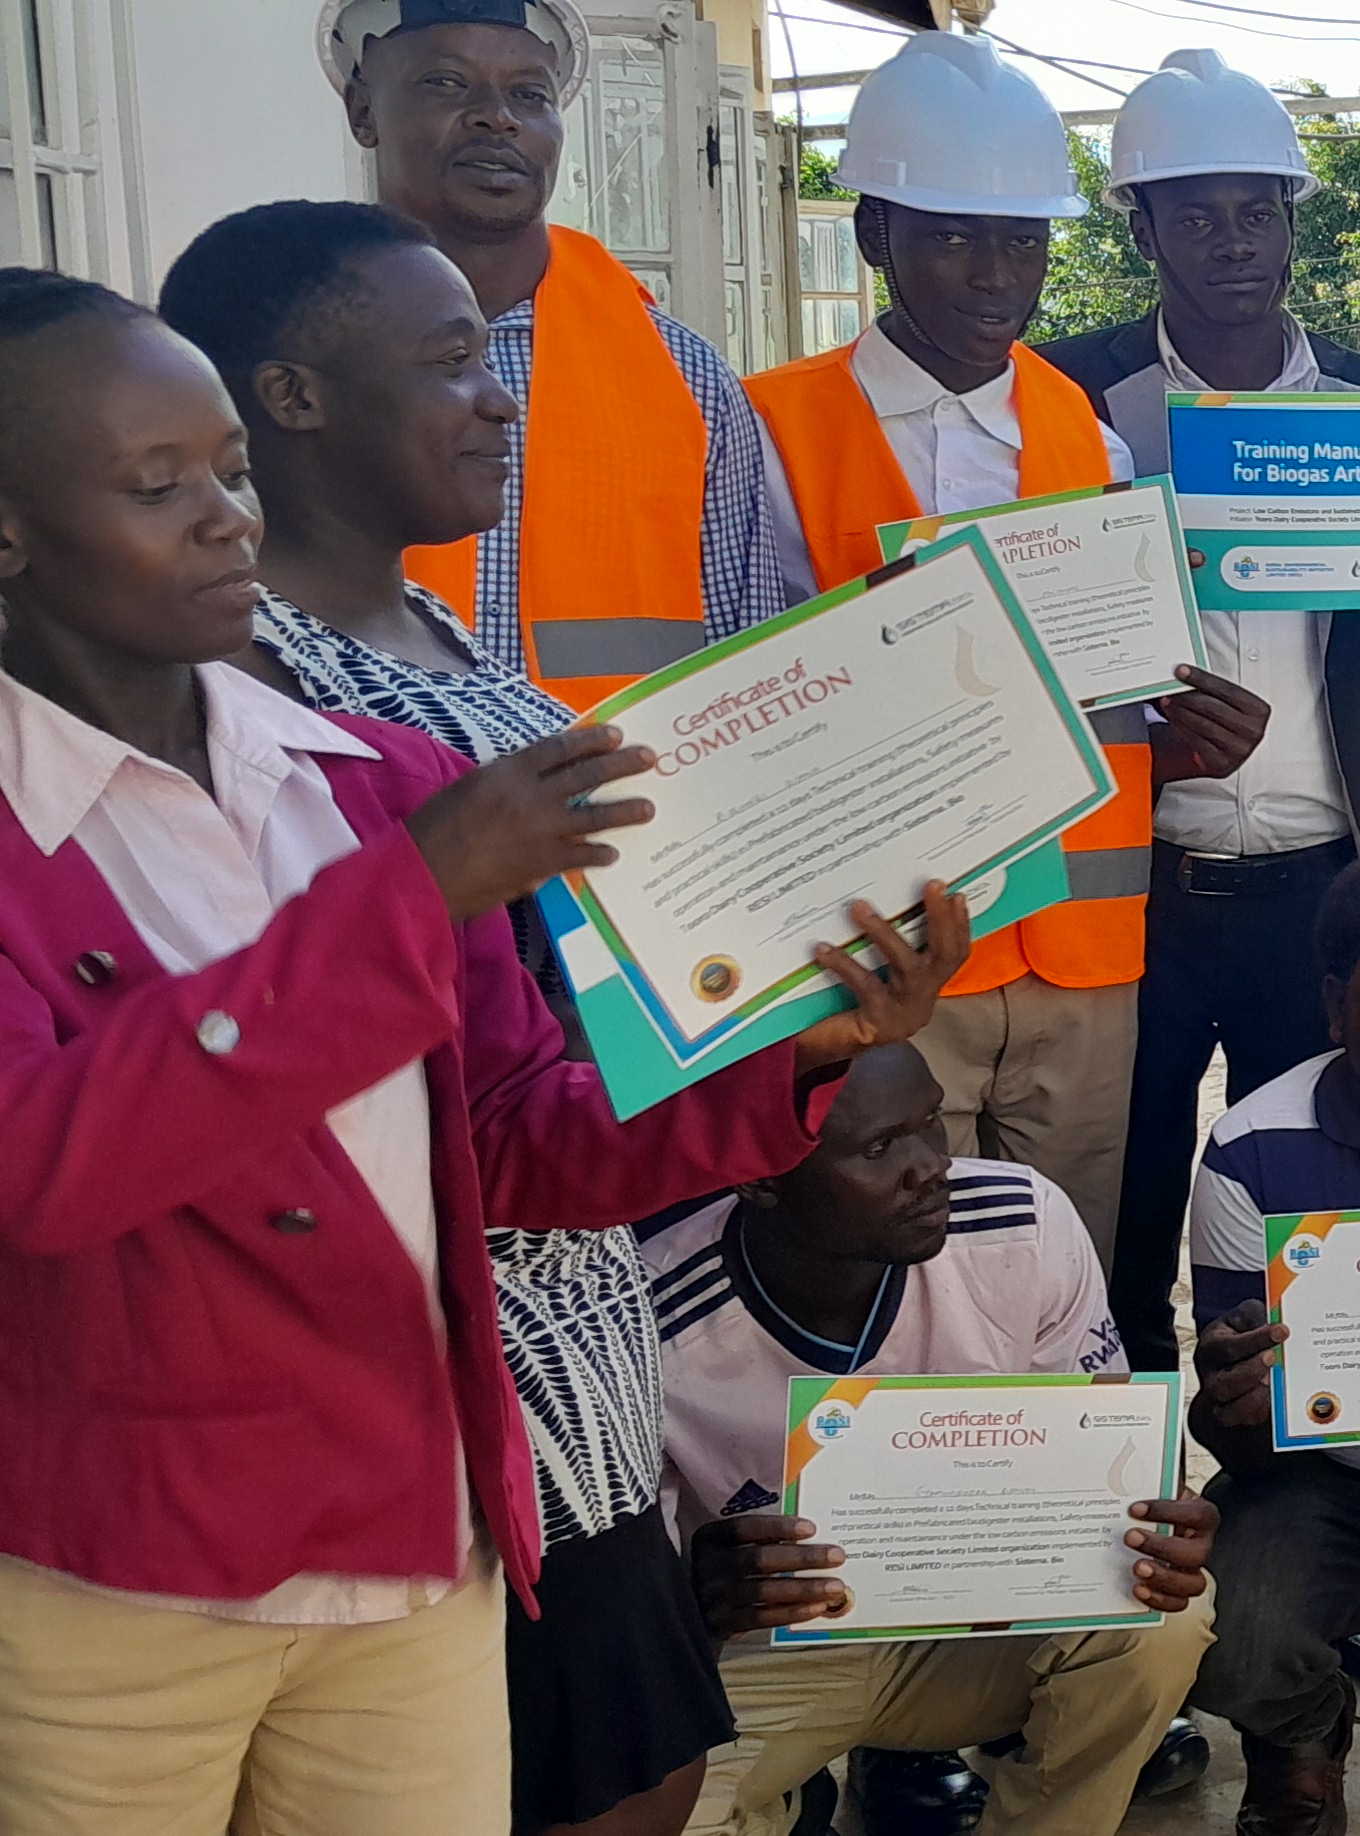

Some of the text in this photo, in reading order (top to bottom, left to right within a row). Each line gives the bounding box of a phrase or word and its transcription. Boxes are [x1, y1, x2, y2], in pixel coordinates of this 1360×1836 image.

[1232, 440, 1309, 463] Training
[1233, 461, 1262, 481] for
[1266, 463, 1329, 486] Biogas
[1047, 522, 1059, 538] of
[1002, 535, 1081, 564] PLETION
[673, 656, 807, 736] Certificate of
[654, 665, 854, 777] COMPLETION
[918, 1408, 1024, 1427] Certificate of
[890, 1427, 1046, 1449] COMPLETION
